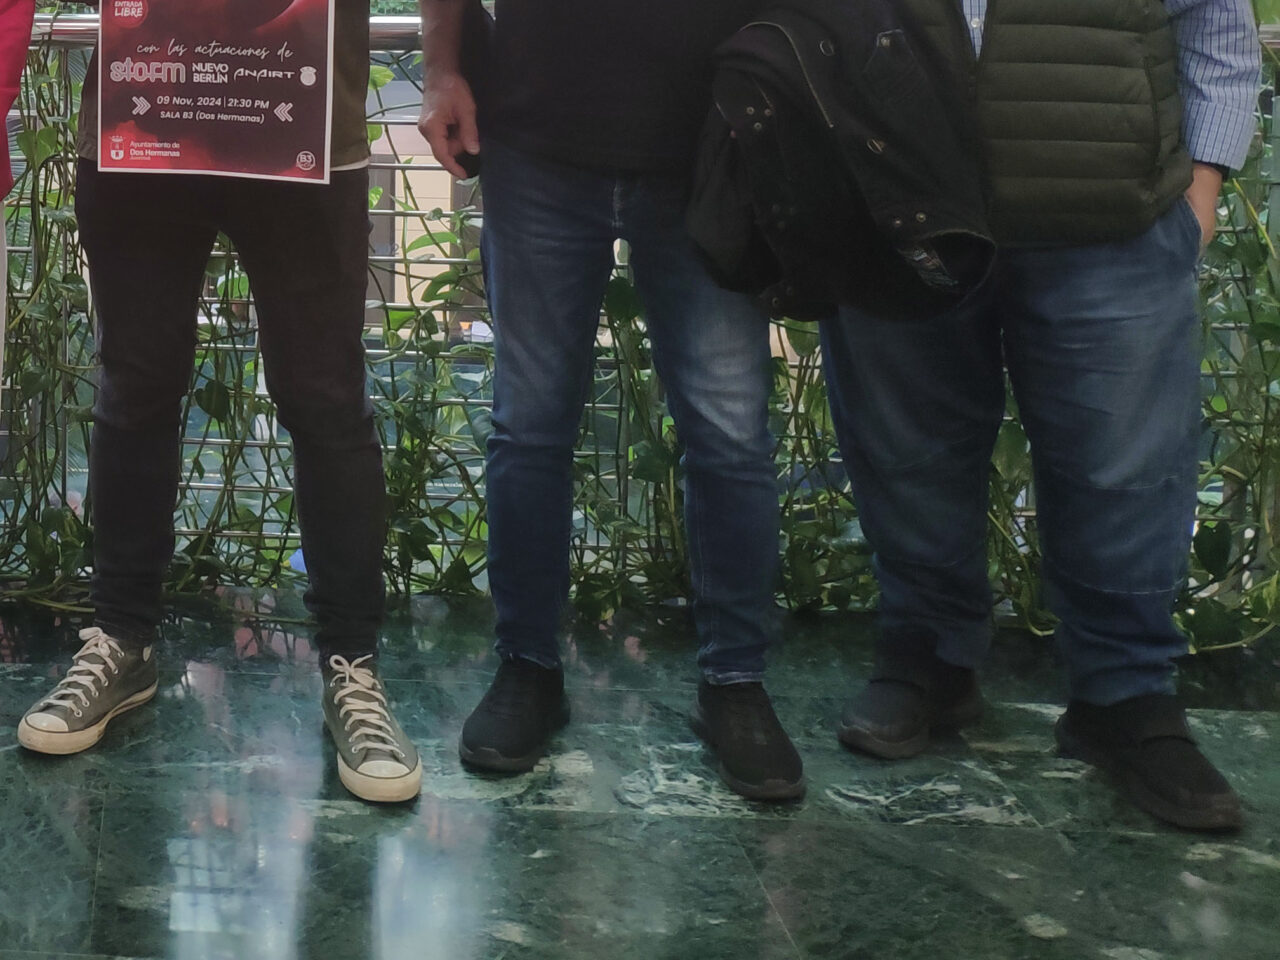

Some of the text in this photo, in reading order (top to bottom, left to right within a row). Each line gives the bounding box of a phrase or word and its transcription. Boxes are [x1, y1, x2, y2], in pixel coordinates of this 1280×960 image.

[114, 0, 143, 8] ENTRADA
[114, 7, 143, 18] LIBRE
[136, 38, 294, 62] con las actuaciones de
[192, 62, 229, 73] NUEVO
[156, 95, 270, 109] 09 Nov, 2024 21:30 PM
[160, 111, 265, 124] SALA B3 (Dos Hermanas)
[130, 148, 180, 157] Dos Hermanas
